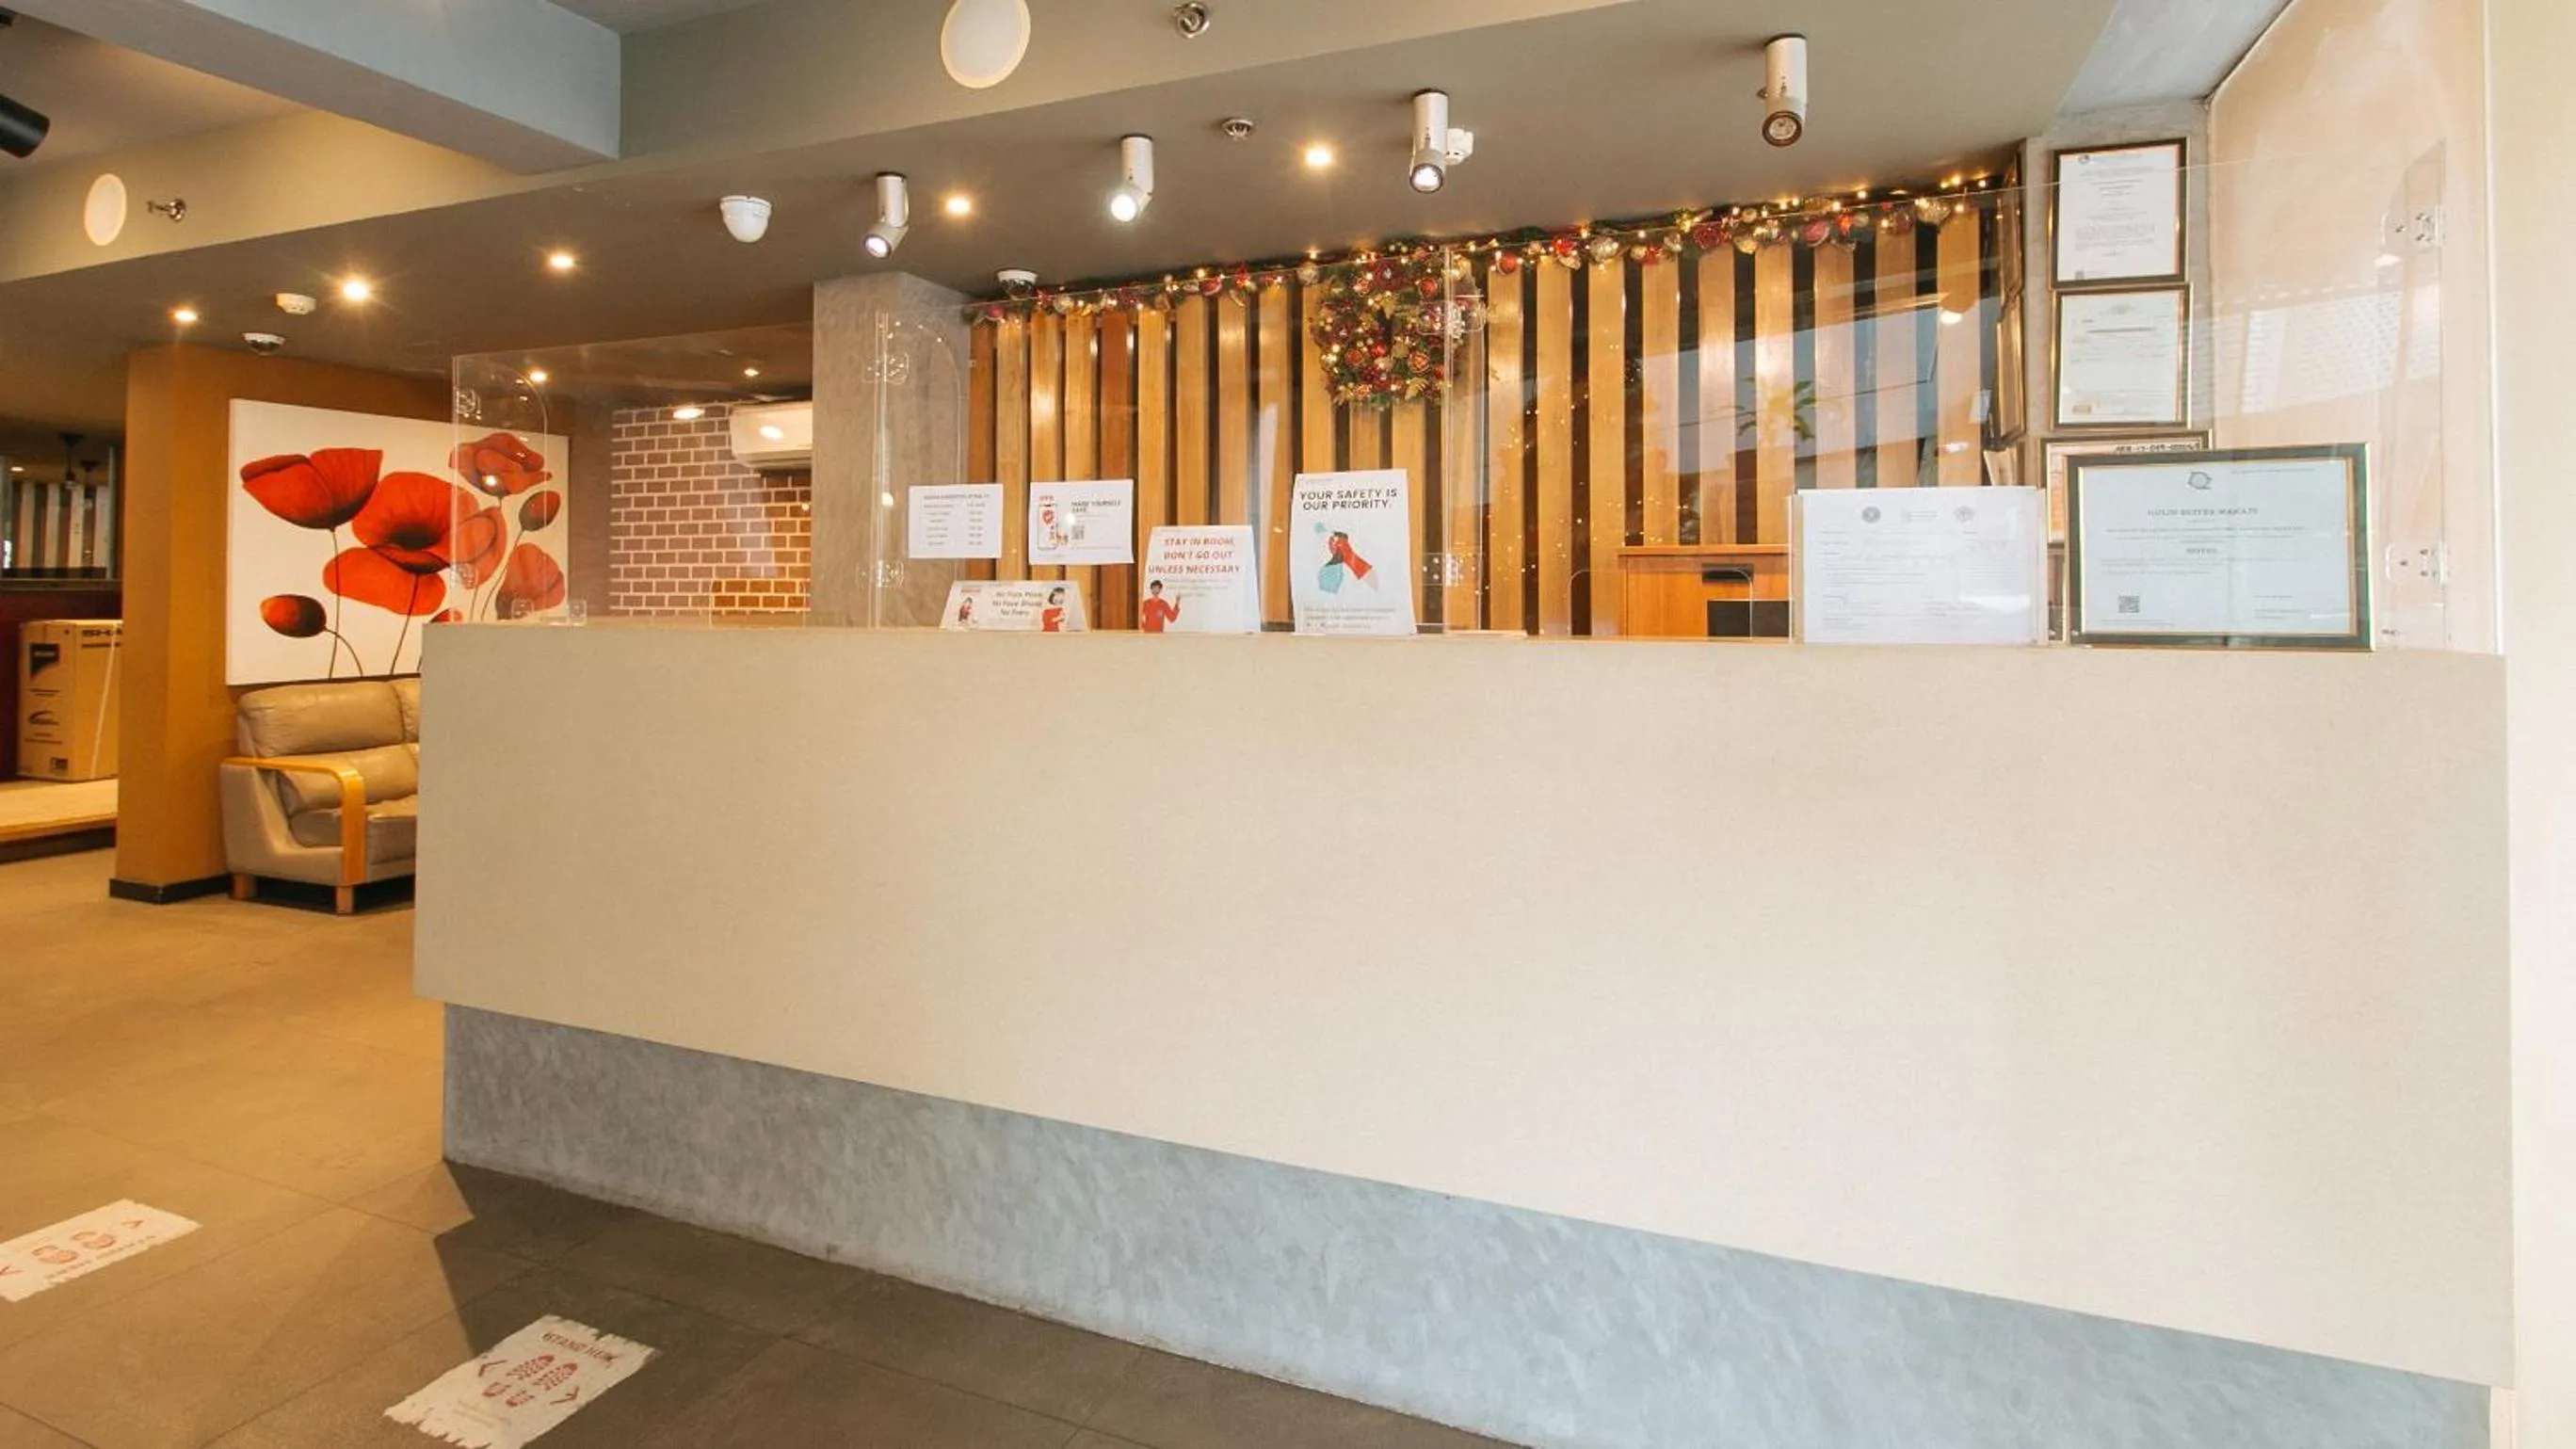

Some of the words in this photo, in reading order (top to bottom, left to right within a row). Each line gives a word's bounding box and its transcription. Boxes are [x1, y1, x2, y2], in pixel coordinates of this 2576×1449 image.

[1300, 491, 1333, 500] YOUR
[1337, 489, 1381, 499] SAFETY
[1387, 489, 1398, 497] IS
[1303, 501, 1328, 510] OUR
[1165, 538, 1186, 546] STAY
[1189, 538, 1201, 546] IN
[1164, 551, 1193, 560] DON'T
[1196, 551, 1210, 559] GO
[1212, 551, 1232, 560] OUT
[1149, 565, 1183, 573] UNLESS
[1185, 565, 1240, 573] NECESSARY
